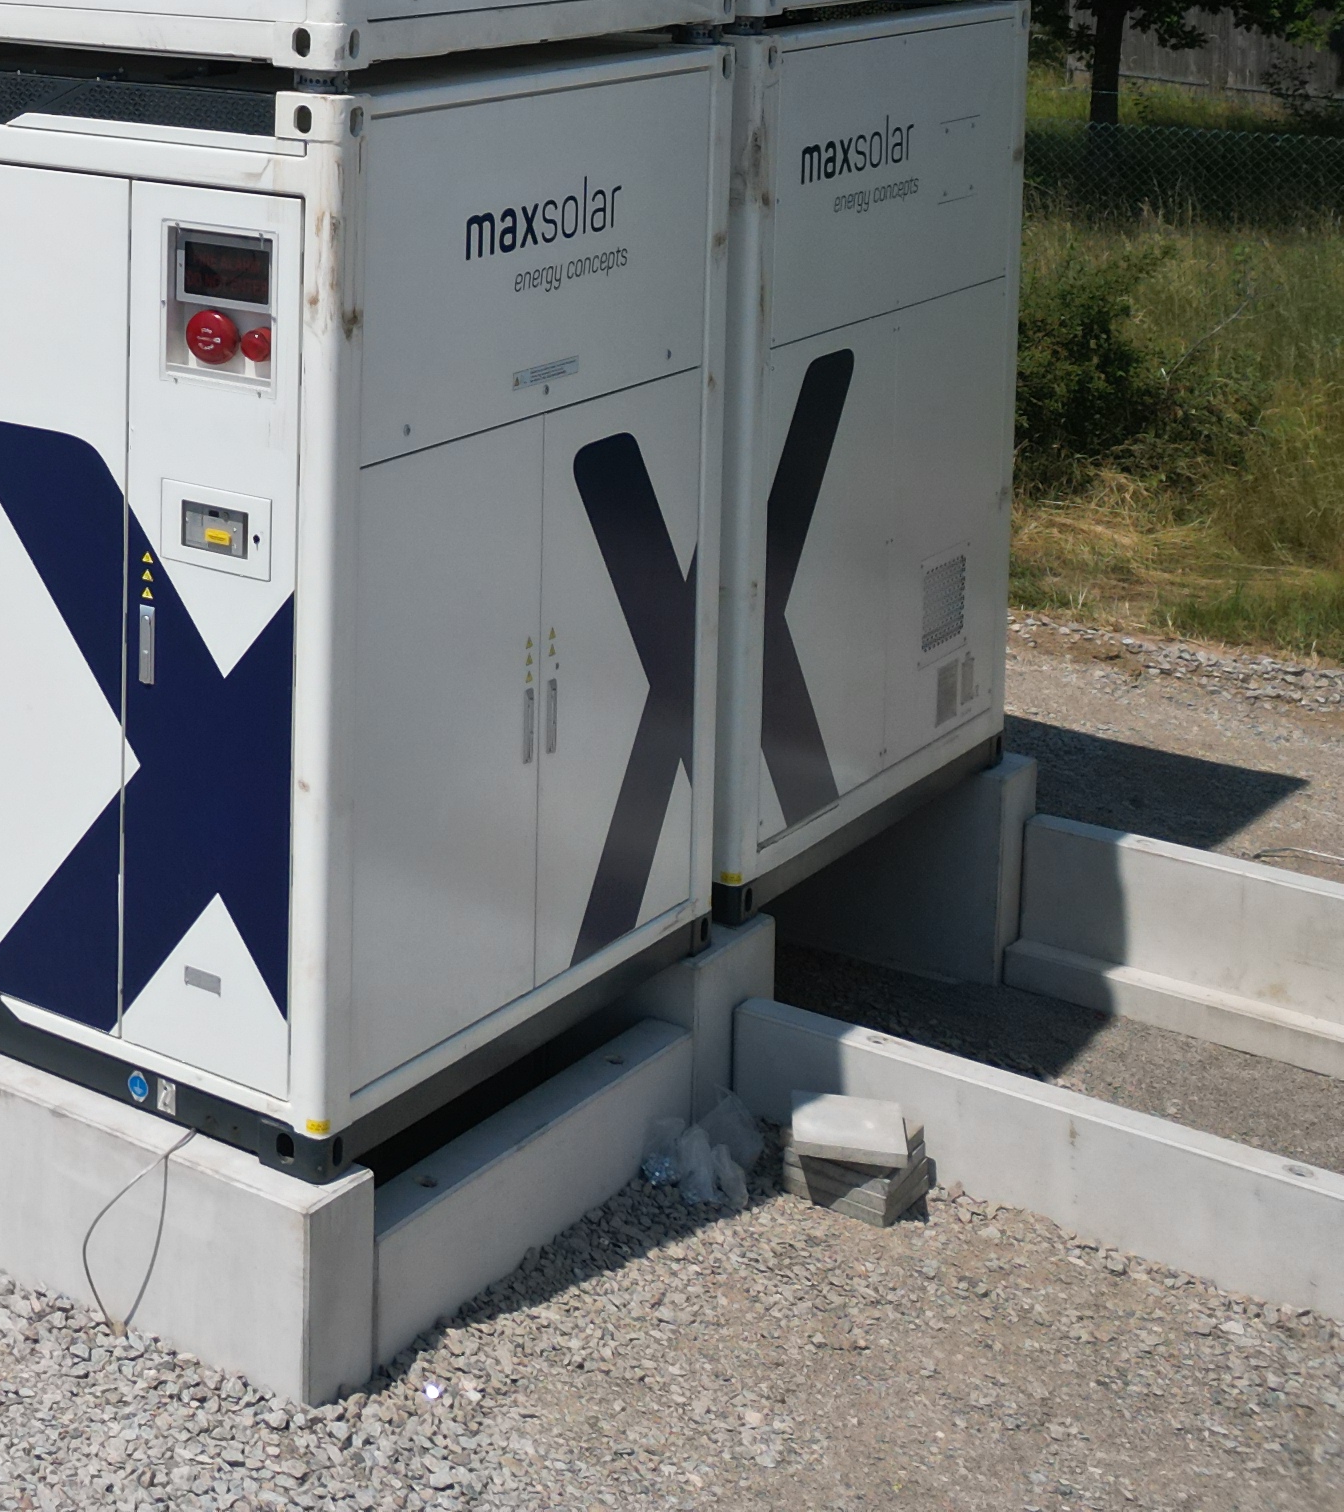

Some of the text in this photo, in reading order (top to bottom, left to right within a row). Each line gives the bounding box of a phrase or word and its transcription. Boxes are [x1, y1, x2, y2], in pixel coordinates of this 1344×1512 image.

[801, 115, 915, 185] maxsolar
[465, 176, 622, 261] maxsolar
[834, 178, 919, 214] energy concepts
[514, 248, 628, 293] energy concepts
